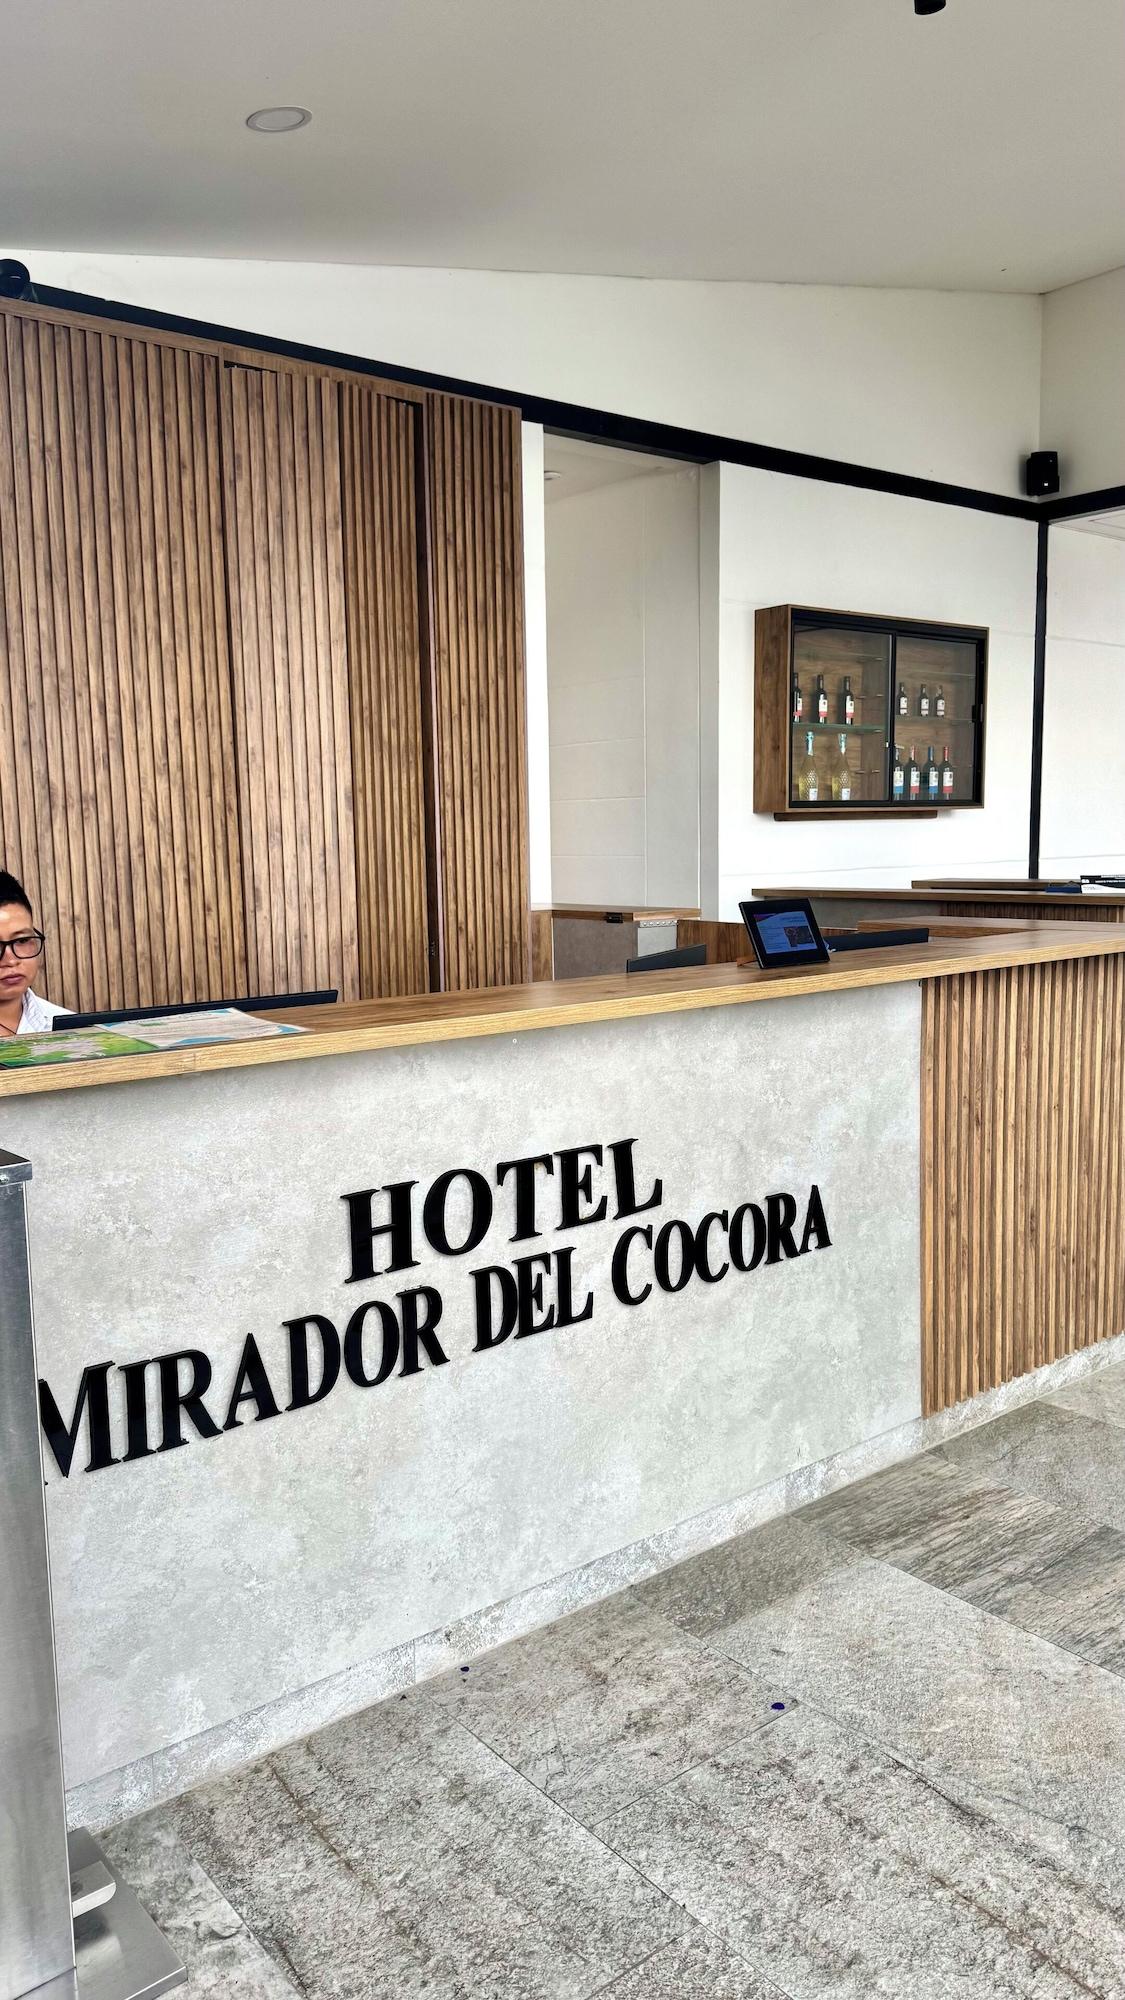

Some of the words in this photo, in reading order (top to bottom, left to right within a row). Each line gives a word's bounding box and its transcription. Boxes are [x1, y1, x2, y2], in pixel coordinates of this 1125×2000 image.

[340, 1138, 663, 1284] HOTEL
[38, 1285, 450, 1485] MIRADOR
[469, 1247, 594, 1352] DEL
[612, 1184, 832, 1306] COCORA
